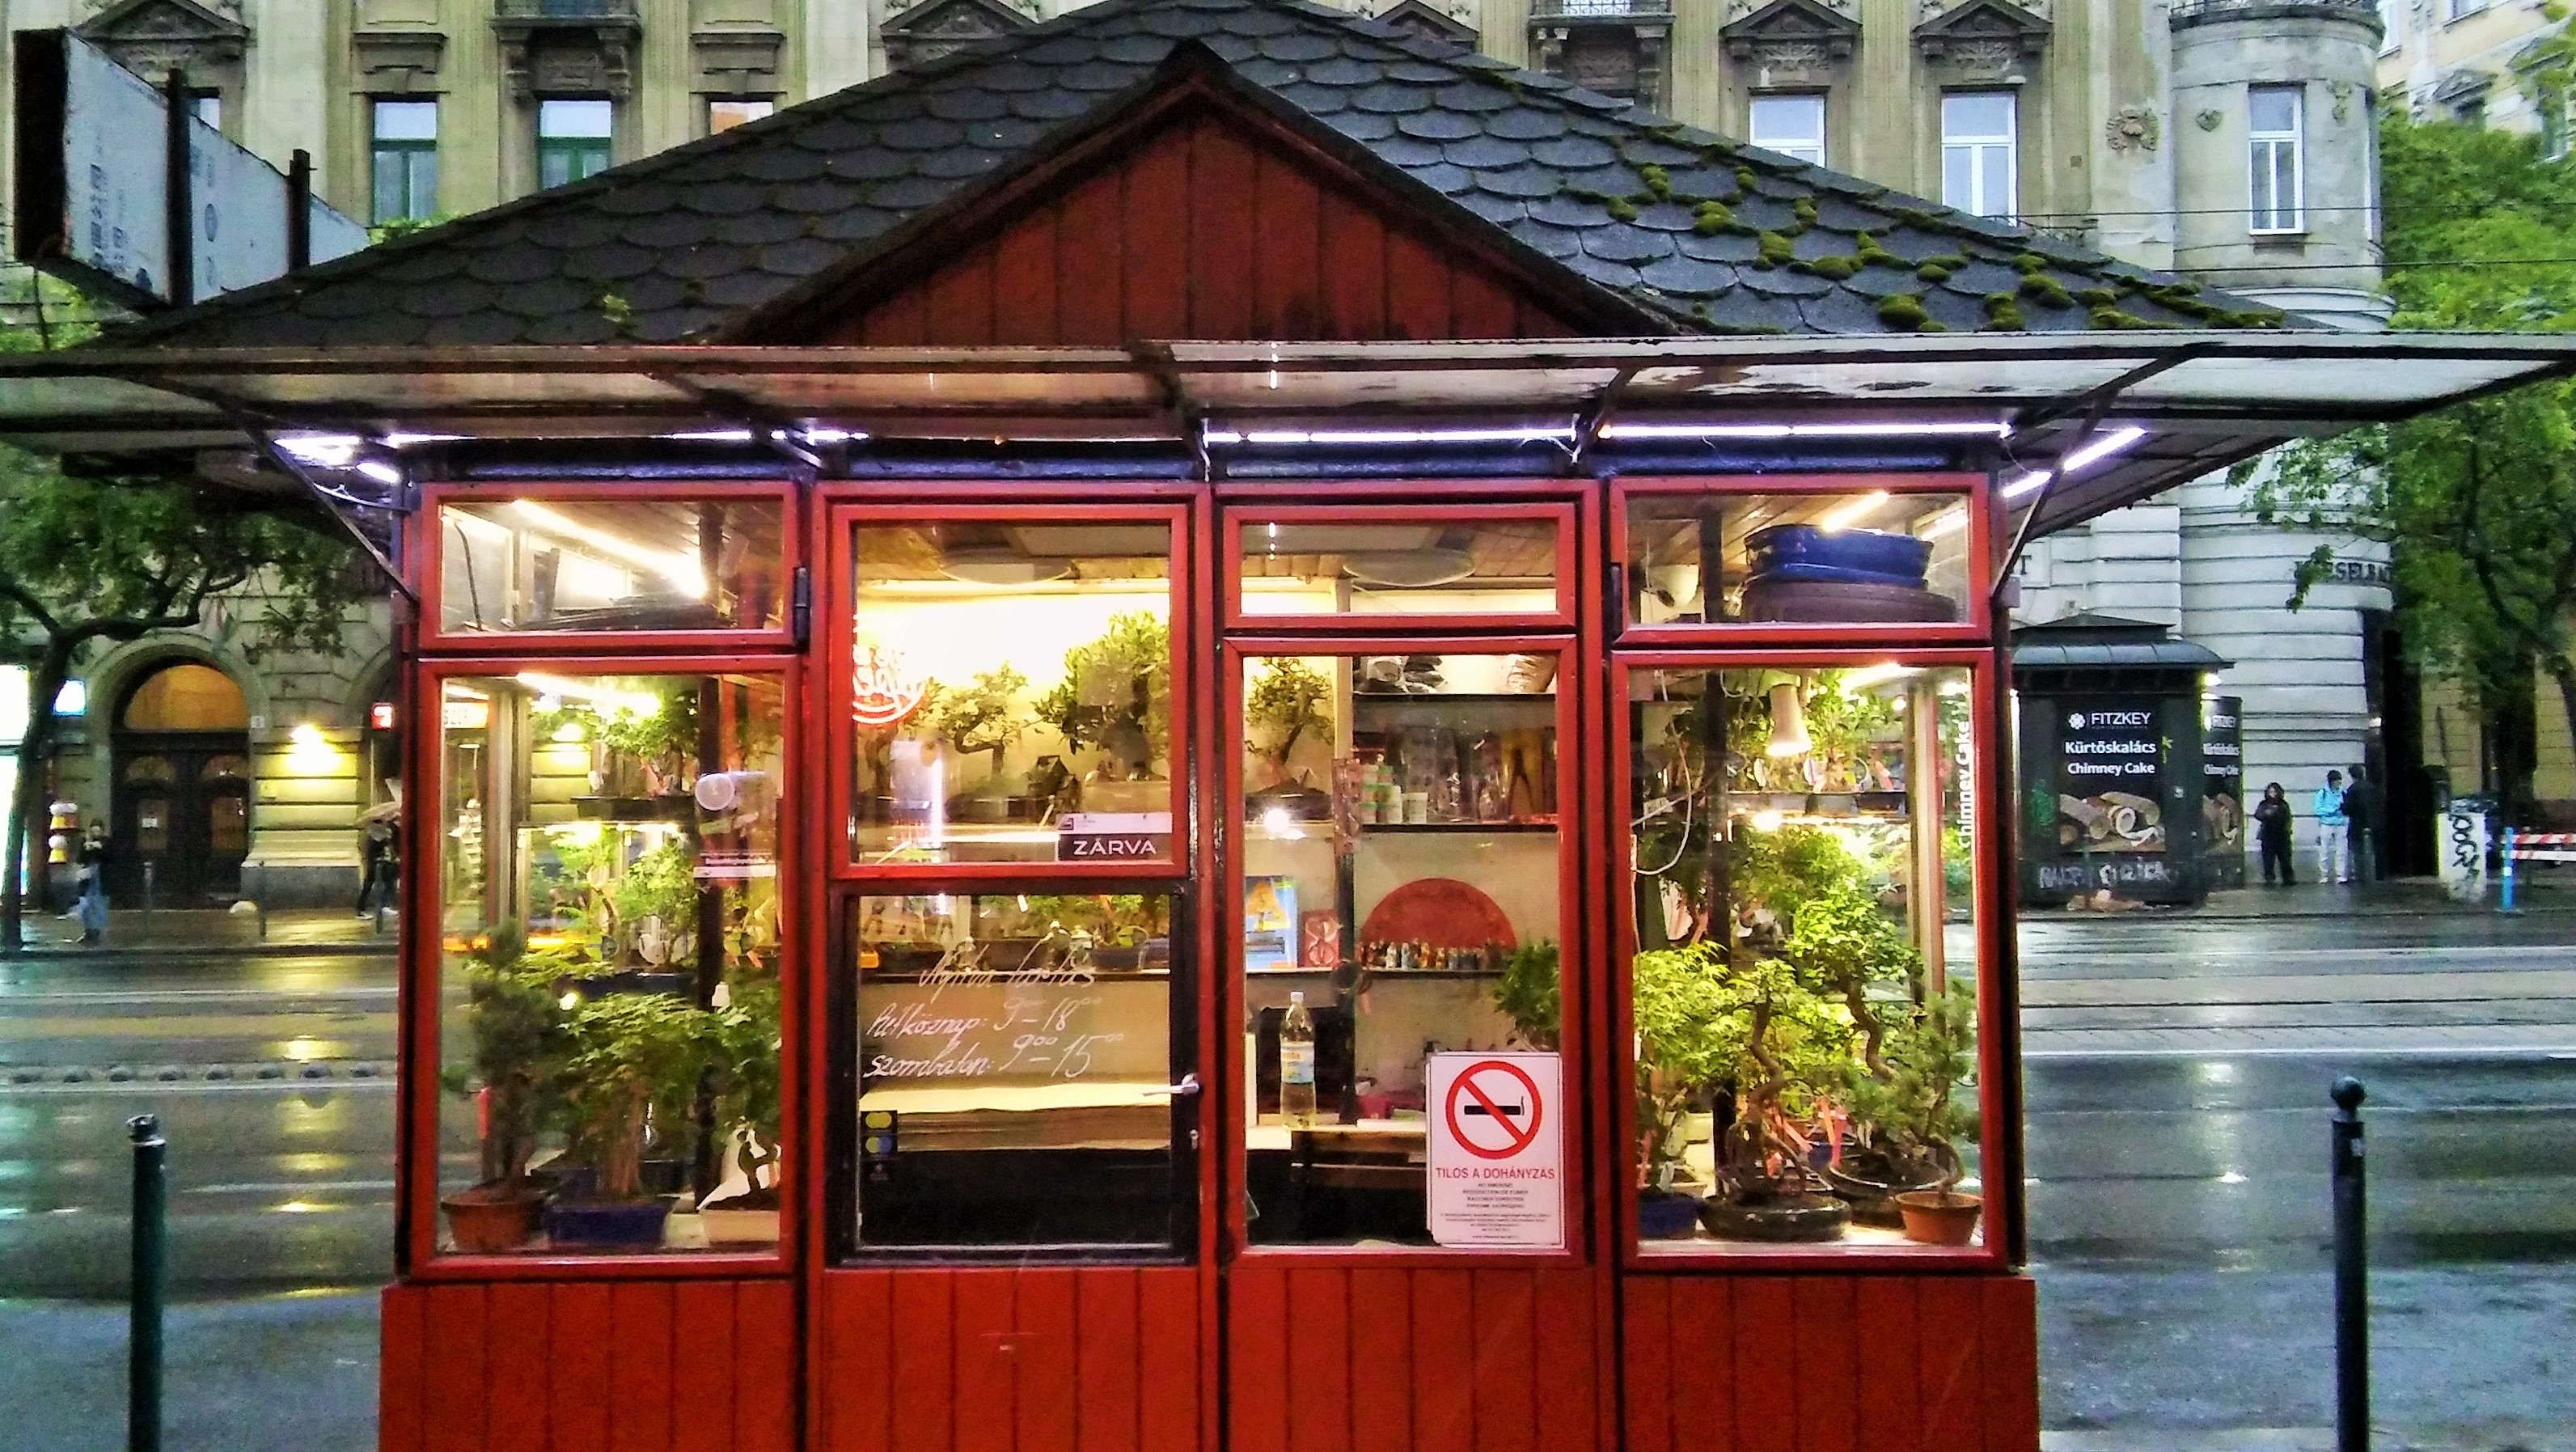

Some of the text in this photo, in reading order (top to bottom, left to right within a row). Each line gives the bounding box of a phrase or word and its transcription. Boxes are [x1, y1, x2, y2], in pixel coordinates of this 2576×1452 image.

[2091, 712, 2151, 725] FITZKEY
[2067, 762, 2155, 777] Chimney Cake
[1072, 837, 1157, 856] ZÁRVA
[1436, 1166, 1470, 1179] TILOS
[1472, 1166, 1480, 1179] A
